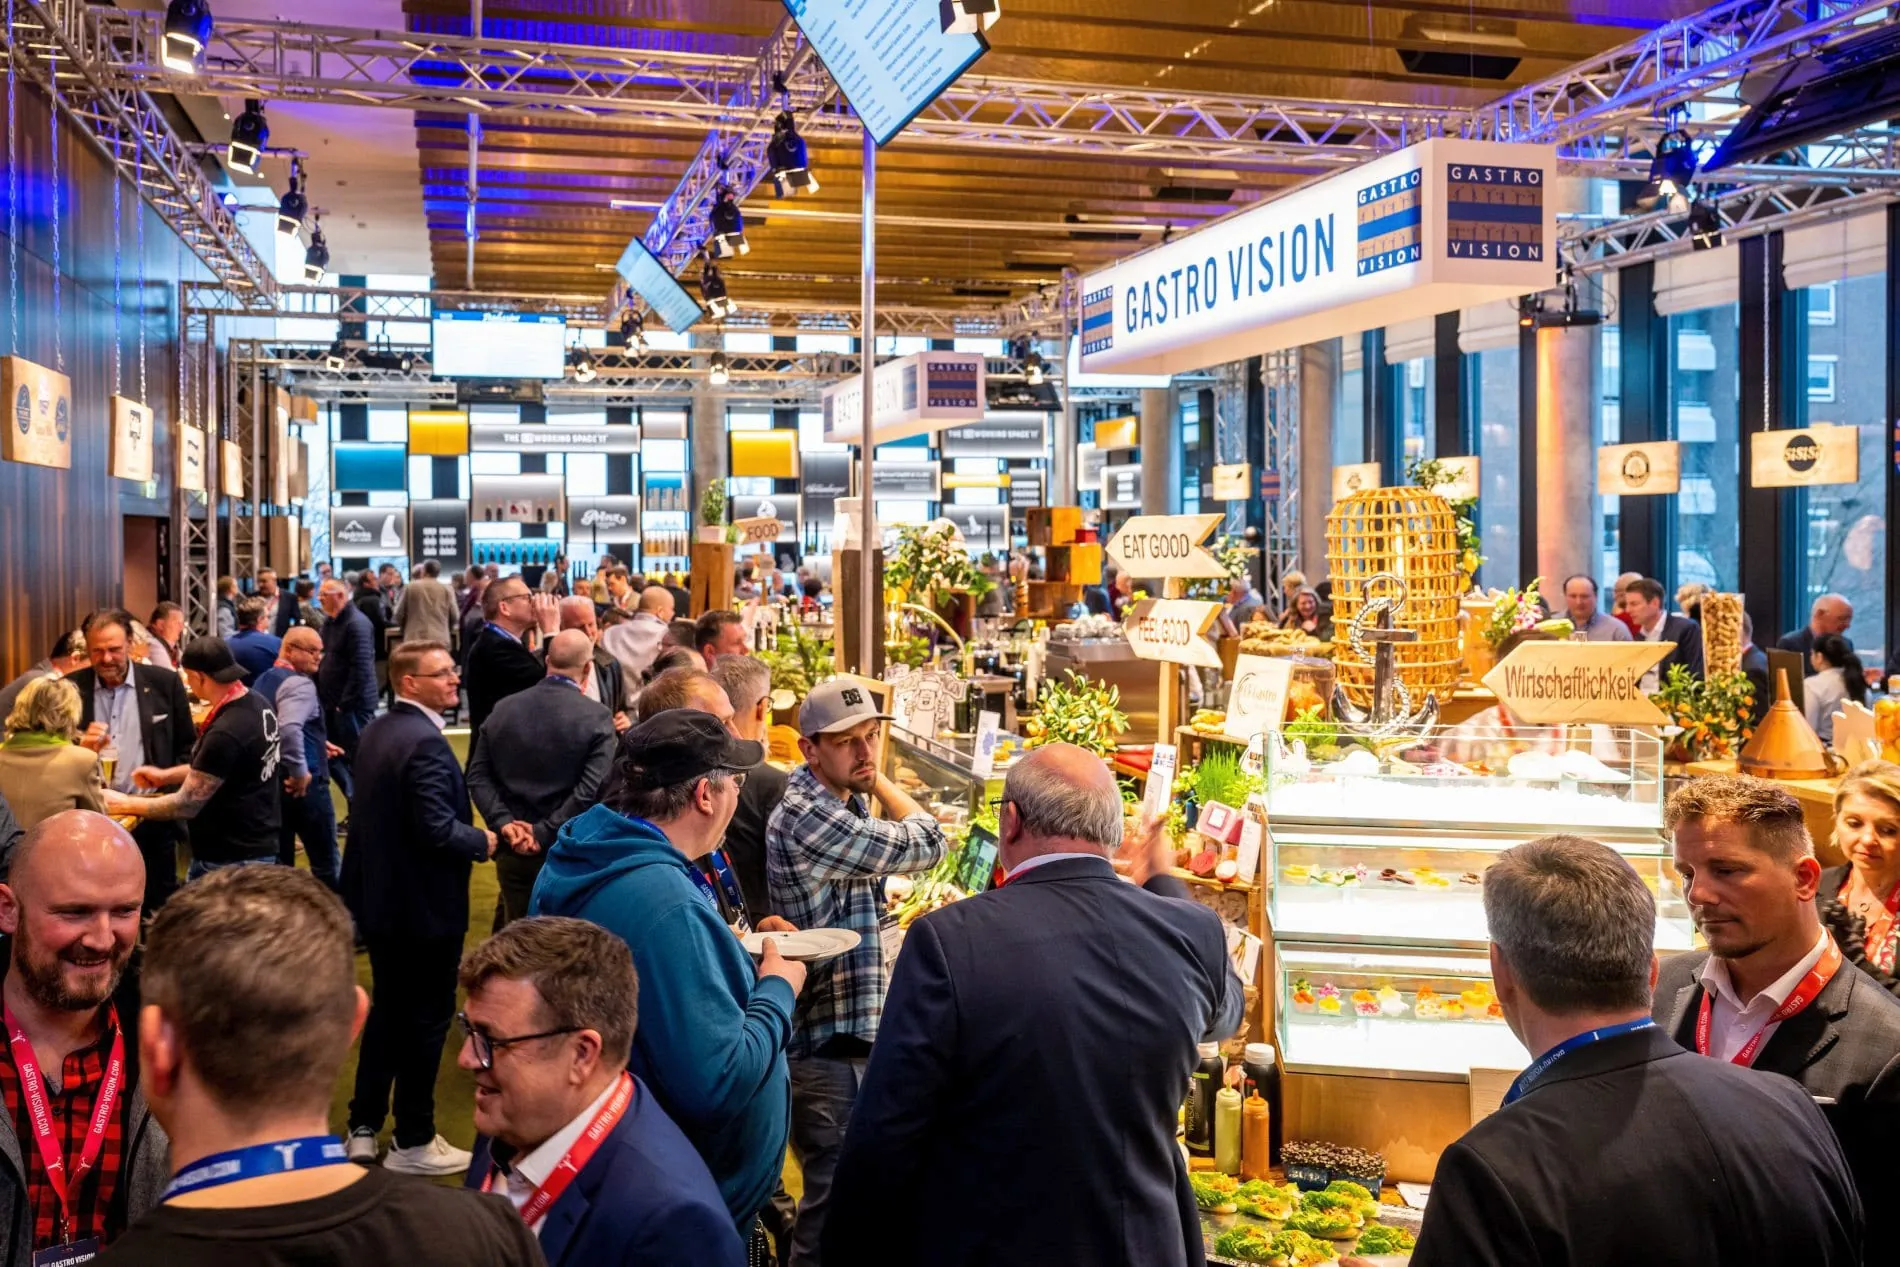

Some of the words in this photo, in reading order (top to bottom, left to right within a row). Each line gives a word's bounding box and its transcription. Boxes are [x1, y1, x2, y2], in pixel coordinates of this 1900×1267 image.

[1451, 166, 1541, 185] GASTRO
[1358, 172, 1421, 204] GASTRO
[1358, 246, 1420, 275] VISION
[1451, 242, 1540, 260] VISION
[1126, 256, 1217, 333] GASTRO
[1228, 213, 1335, 301] VISION
[1083, 286, 1113, 306] GASTRO
[1083, 336, 1113, 355] VISION
[928, 363, 977, 372] GASTRO
[928, 399, 977, 408] VISION
[504, 433, 519, 443] THE
[747, 523, 779, 541] FOOD
[1123, 534, 1147, 559] EAT
[1149, 533, 1190, 559] GOOD
[1139, 616, 1160, 642] FEEL
[1161, 618, 1190, 646] GOOD
[1505, 665, 1637, 701] Wirtschaftlichkeit
